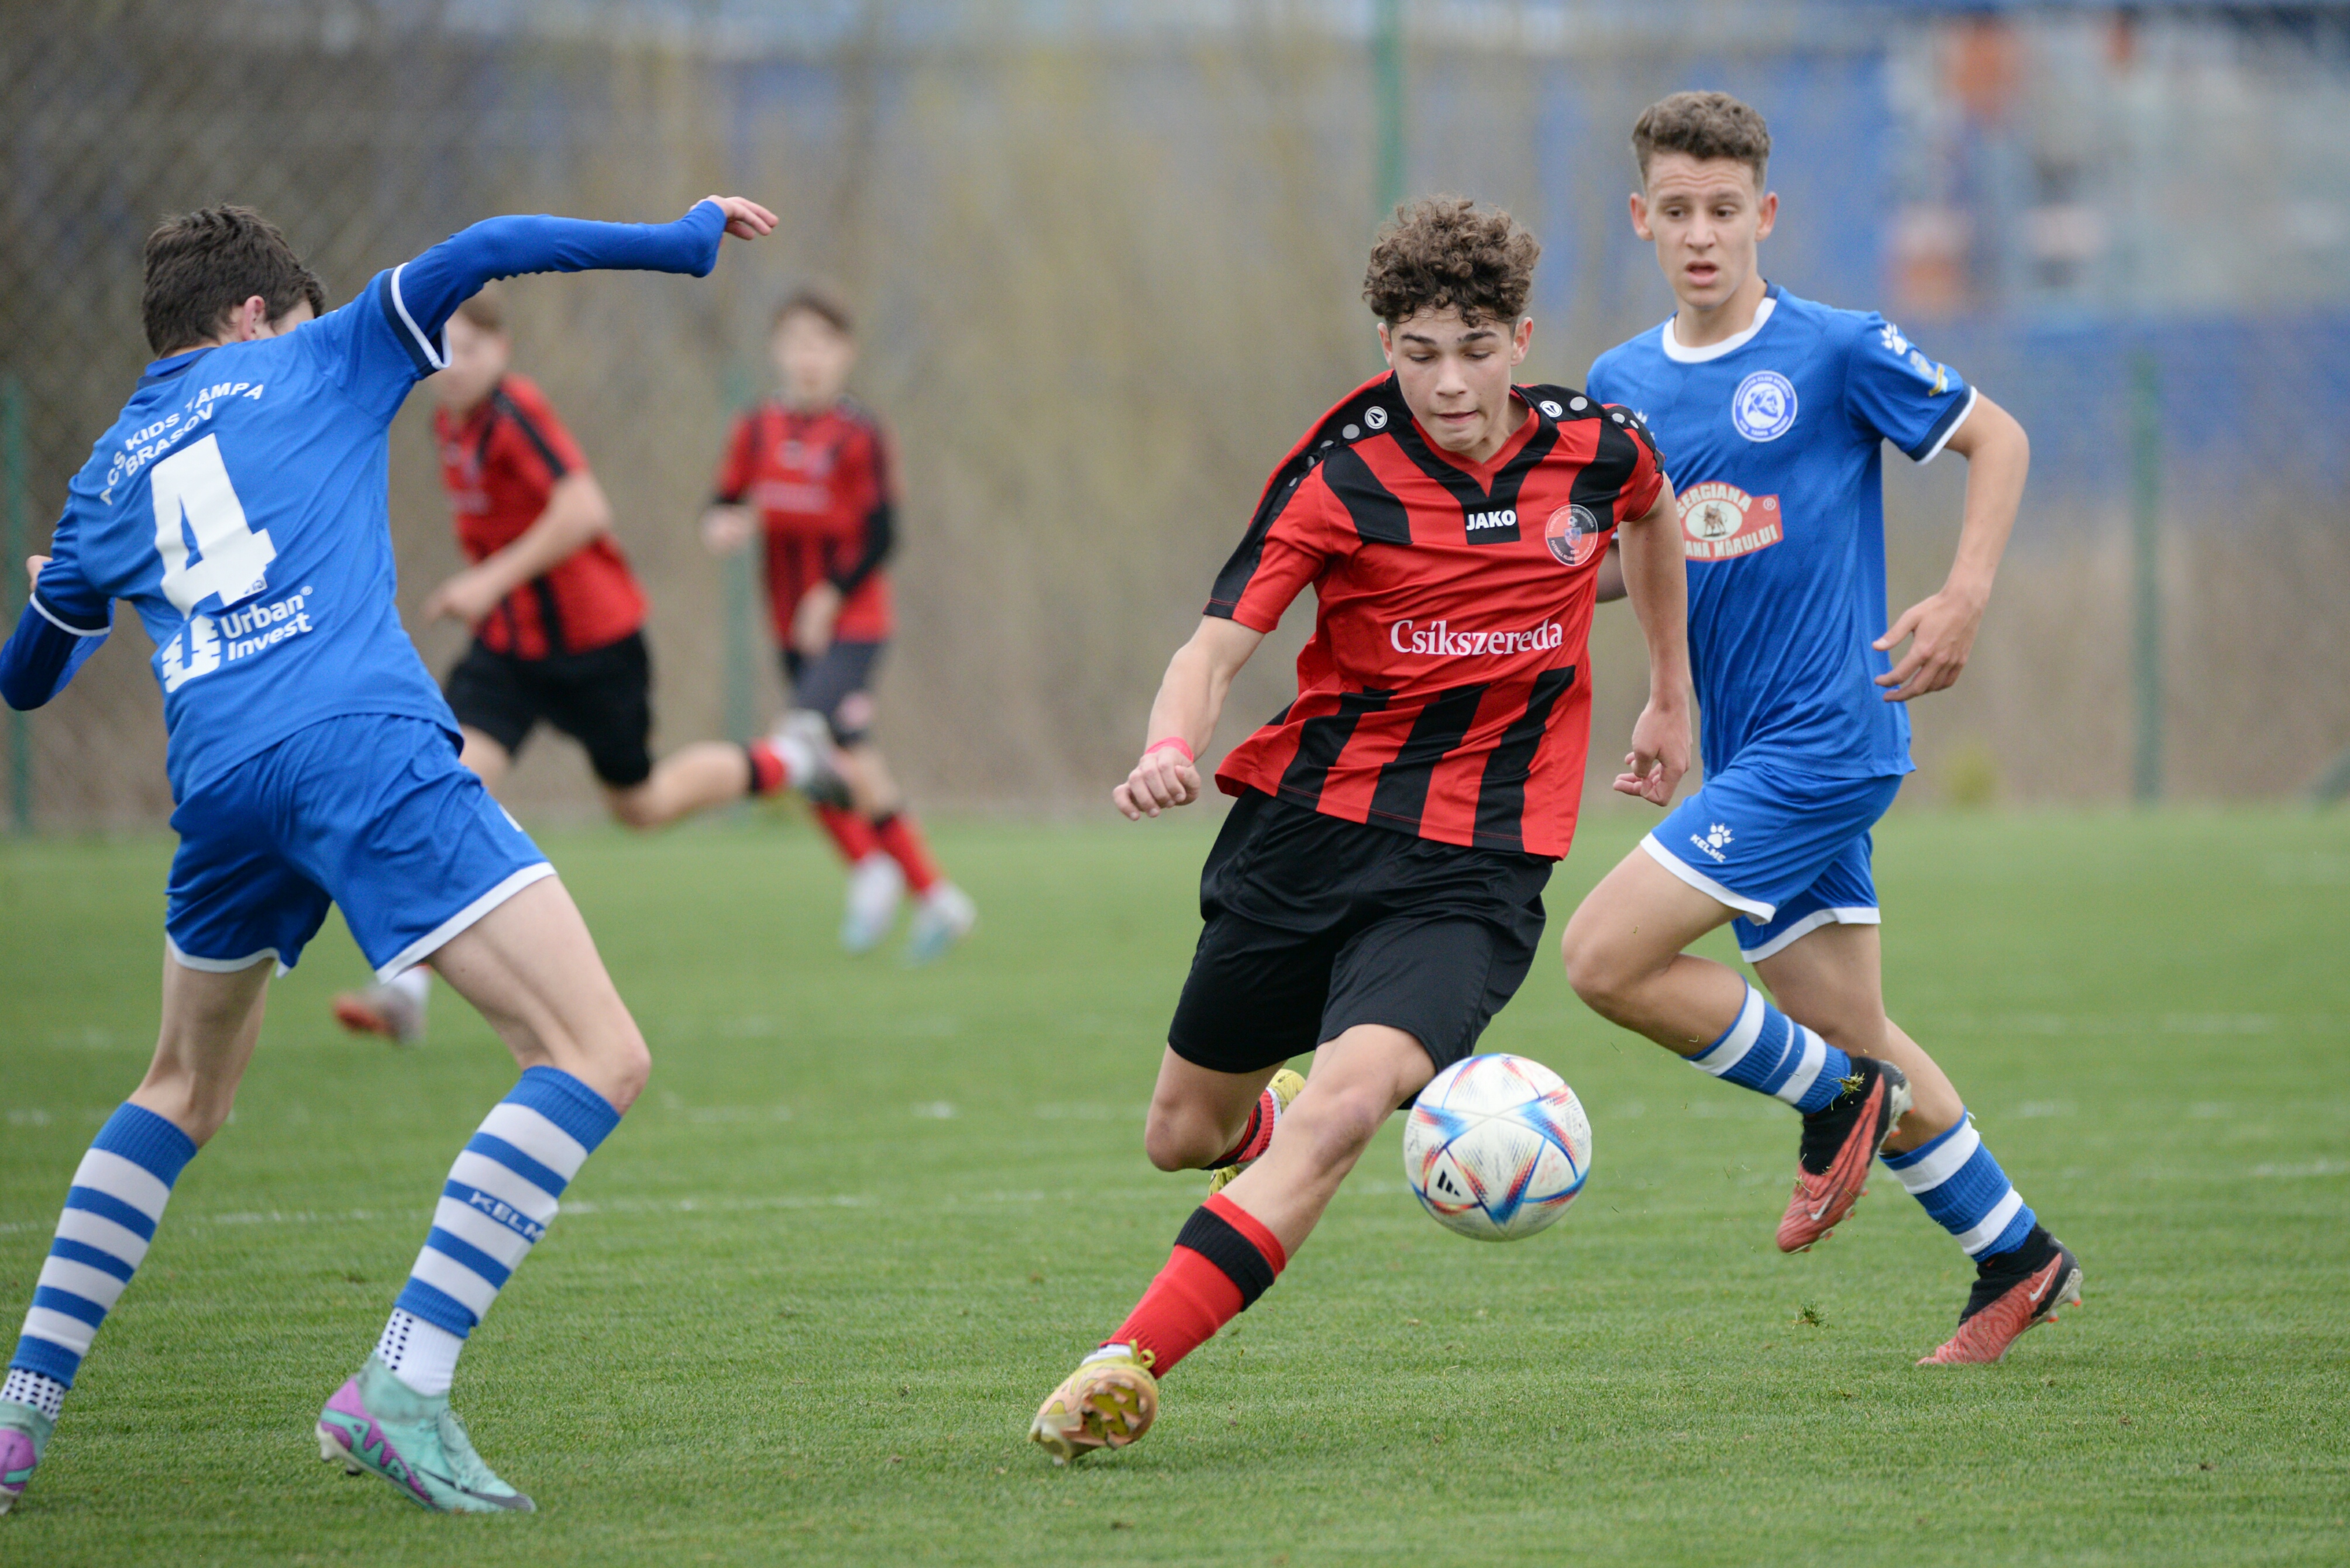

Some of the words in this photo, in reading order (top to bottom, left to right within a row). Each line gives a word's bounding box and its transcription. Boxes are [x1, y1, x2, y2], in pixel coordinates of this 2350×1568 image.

[125, 412, 180, 451] KIDS
[1466, 509, 1516, 531] JAKO
[1677, 484, 1753, 518] SERGIANA
[150, 433, 277, 618] 4
[219, 594, 305, 640] Urban
[228, 612, 314, 661] Invest
[1391, 618, 1563, 656] Csíkszereda
[1690, 833, 1726, 863] KELME
